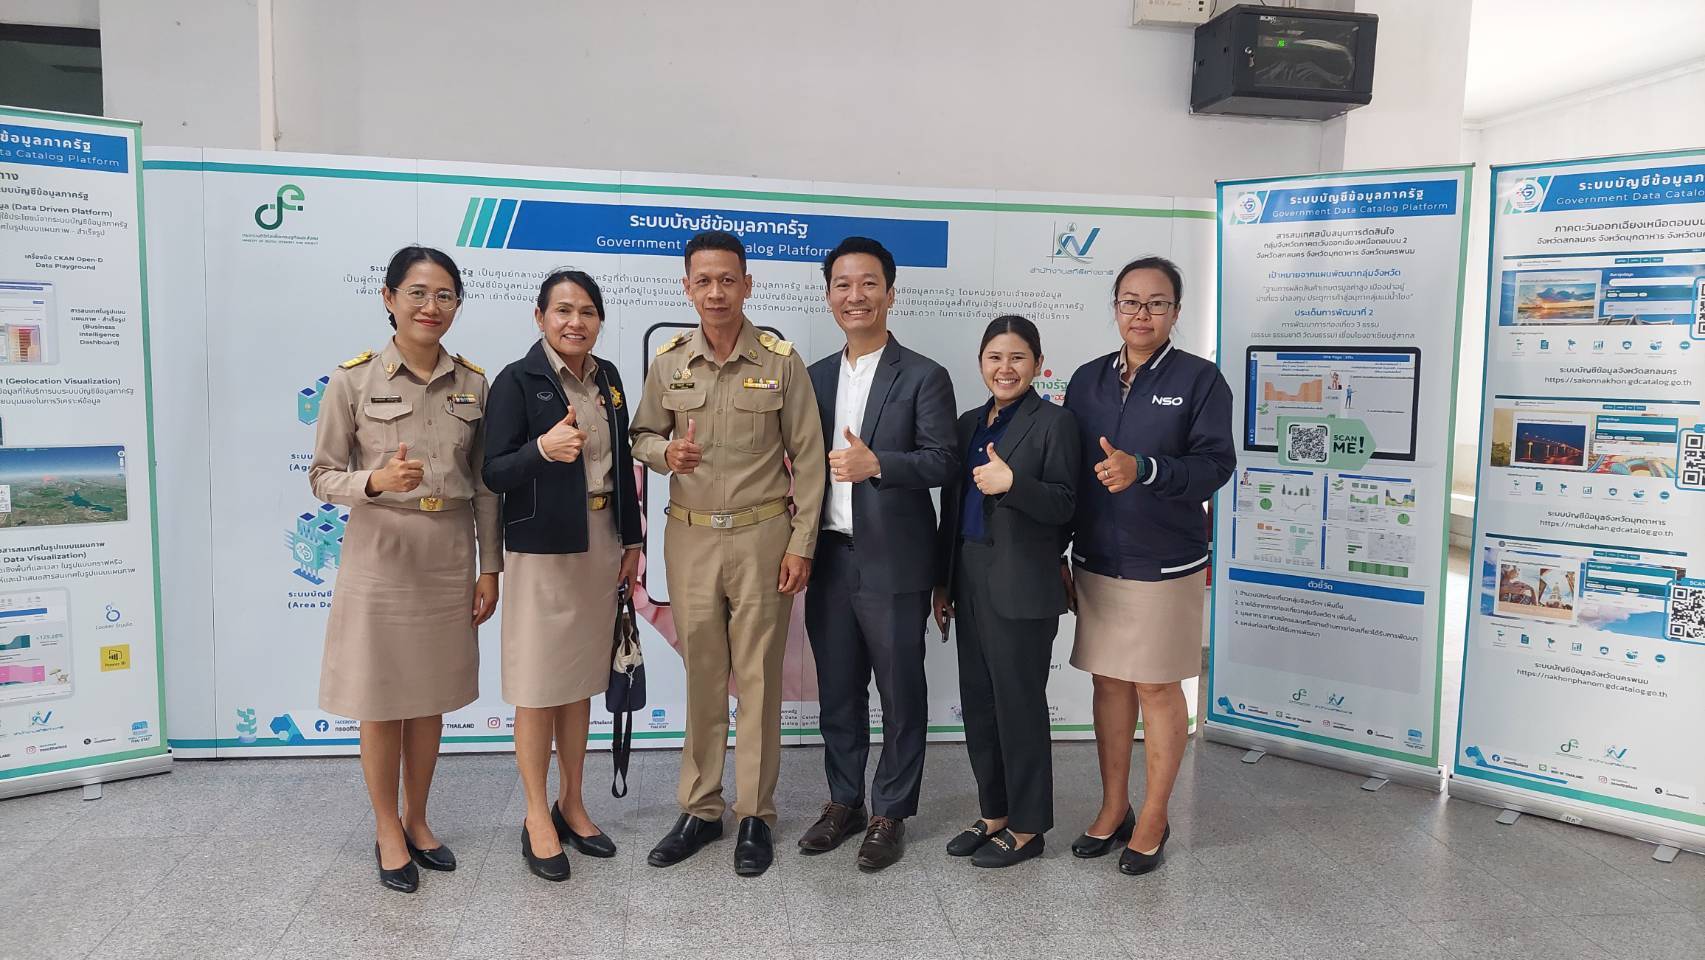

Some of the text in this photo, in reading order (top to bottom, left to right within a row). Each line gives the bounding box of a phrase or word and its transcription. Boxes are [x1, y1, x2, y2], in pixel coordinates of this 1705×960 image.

[0, 149, 120, 167] ta Catalog Platform
[1579, 173, 1705, 191] ระบบบัญชีข้อมูลภ
[1290, 188, 1425, 207] ระบบบัญชีข้อมูลภาครัฐ
[1556, 188, 1705, 206] Government Data Catalo
[12, 204, 37, 213] (Data
[40, 205, 70, 214] Driven
[72, 207, 113, 217] Platform)
[1273, 202, 1449, 218] Government Data Catalog Platform
[630, 213, 808, 239] ระบบบัญชีข้อมูลภาครัฐ
[597, 236, 681, 251] Government
[744, 243, 774, 257] alog
[5, 377, 121, 386] (Geolocation Visualization)
[1152, 394, 1183, 406] NSO
[1333, 434, 1357, 442] SCAN
[1333, 437, 1365, 455] ME!
[290, 452, 313, 460] ระบบ
[288, 590, 332, 599] ระบบบัญชี
[288, 602, 316, 611] (Area
